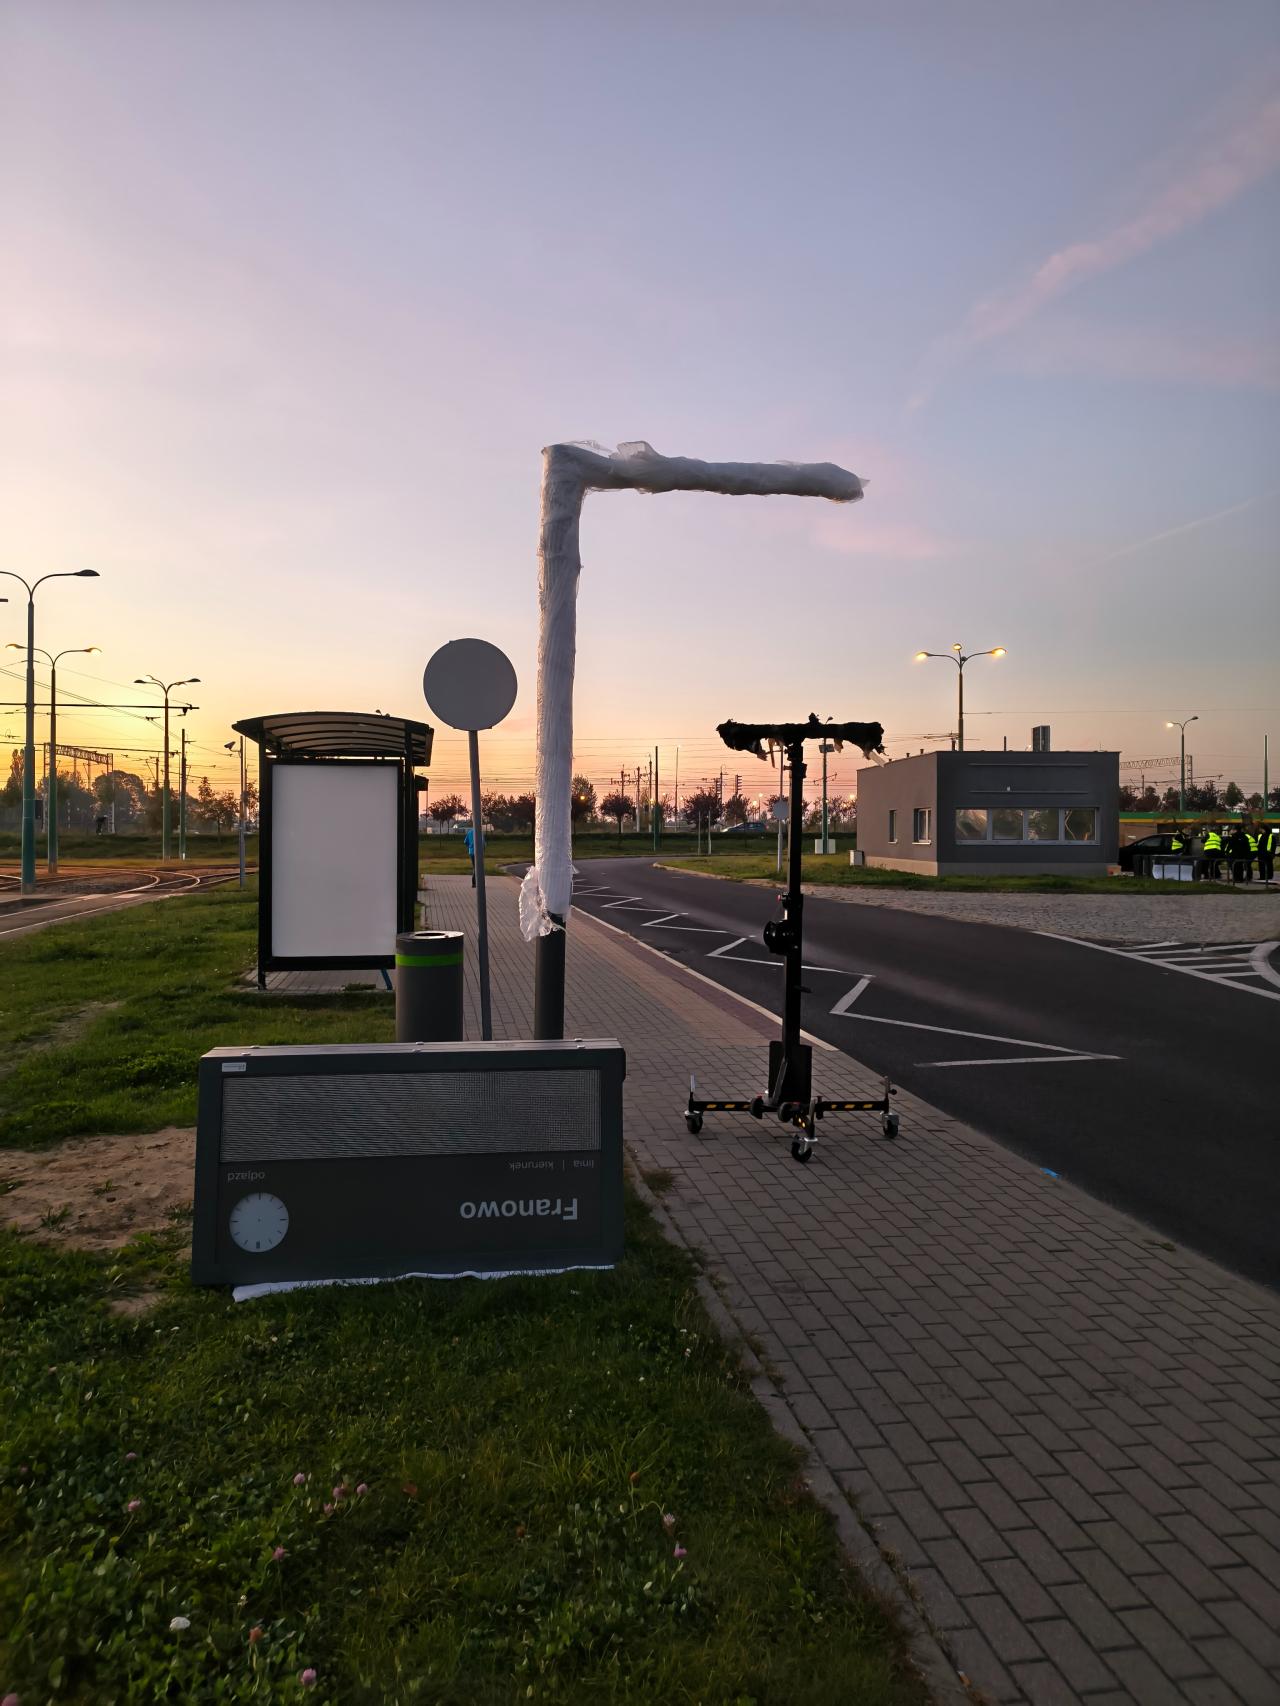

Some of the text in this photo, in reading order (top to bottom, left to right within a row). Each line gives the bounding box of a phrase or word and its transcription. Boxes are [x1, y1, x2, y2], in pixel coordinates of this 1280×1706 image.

[509, 1159, 554, 1171] kierunek
[227, 1170, 265, 1182] odjazd
[460, 1198, 578, 1220] Franowo
